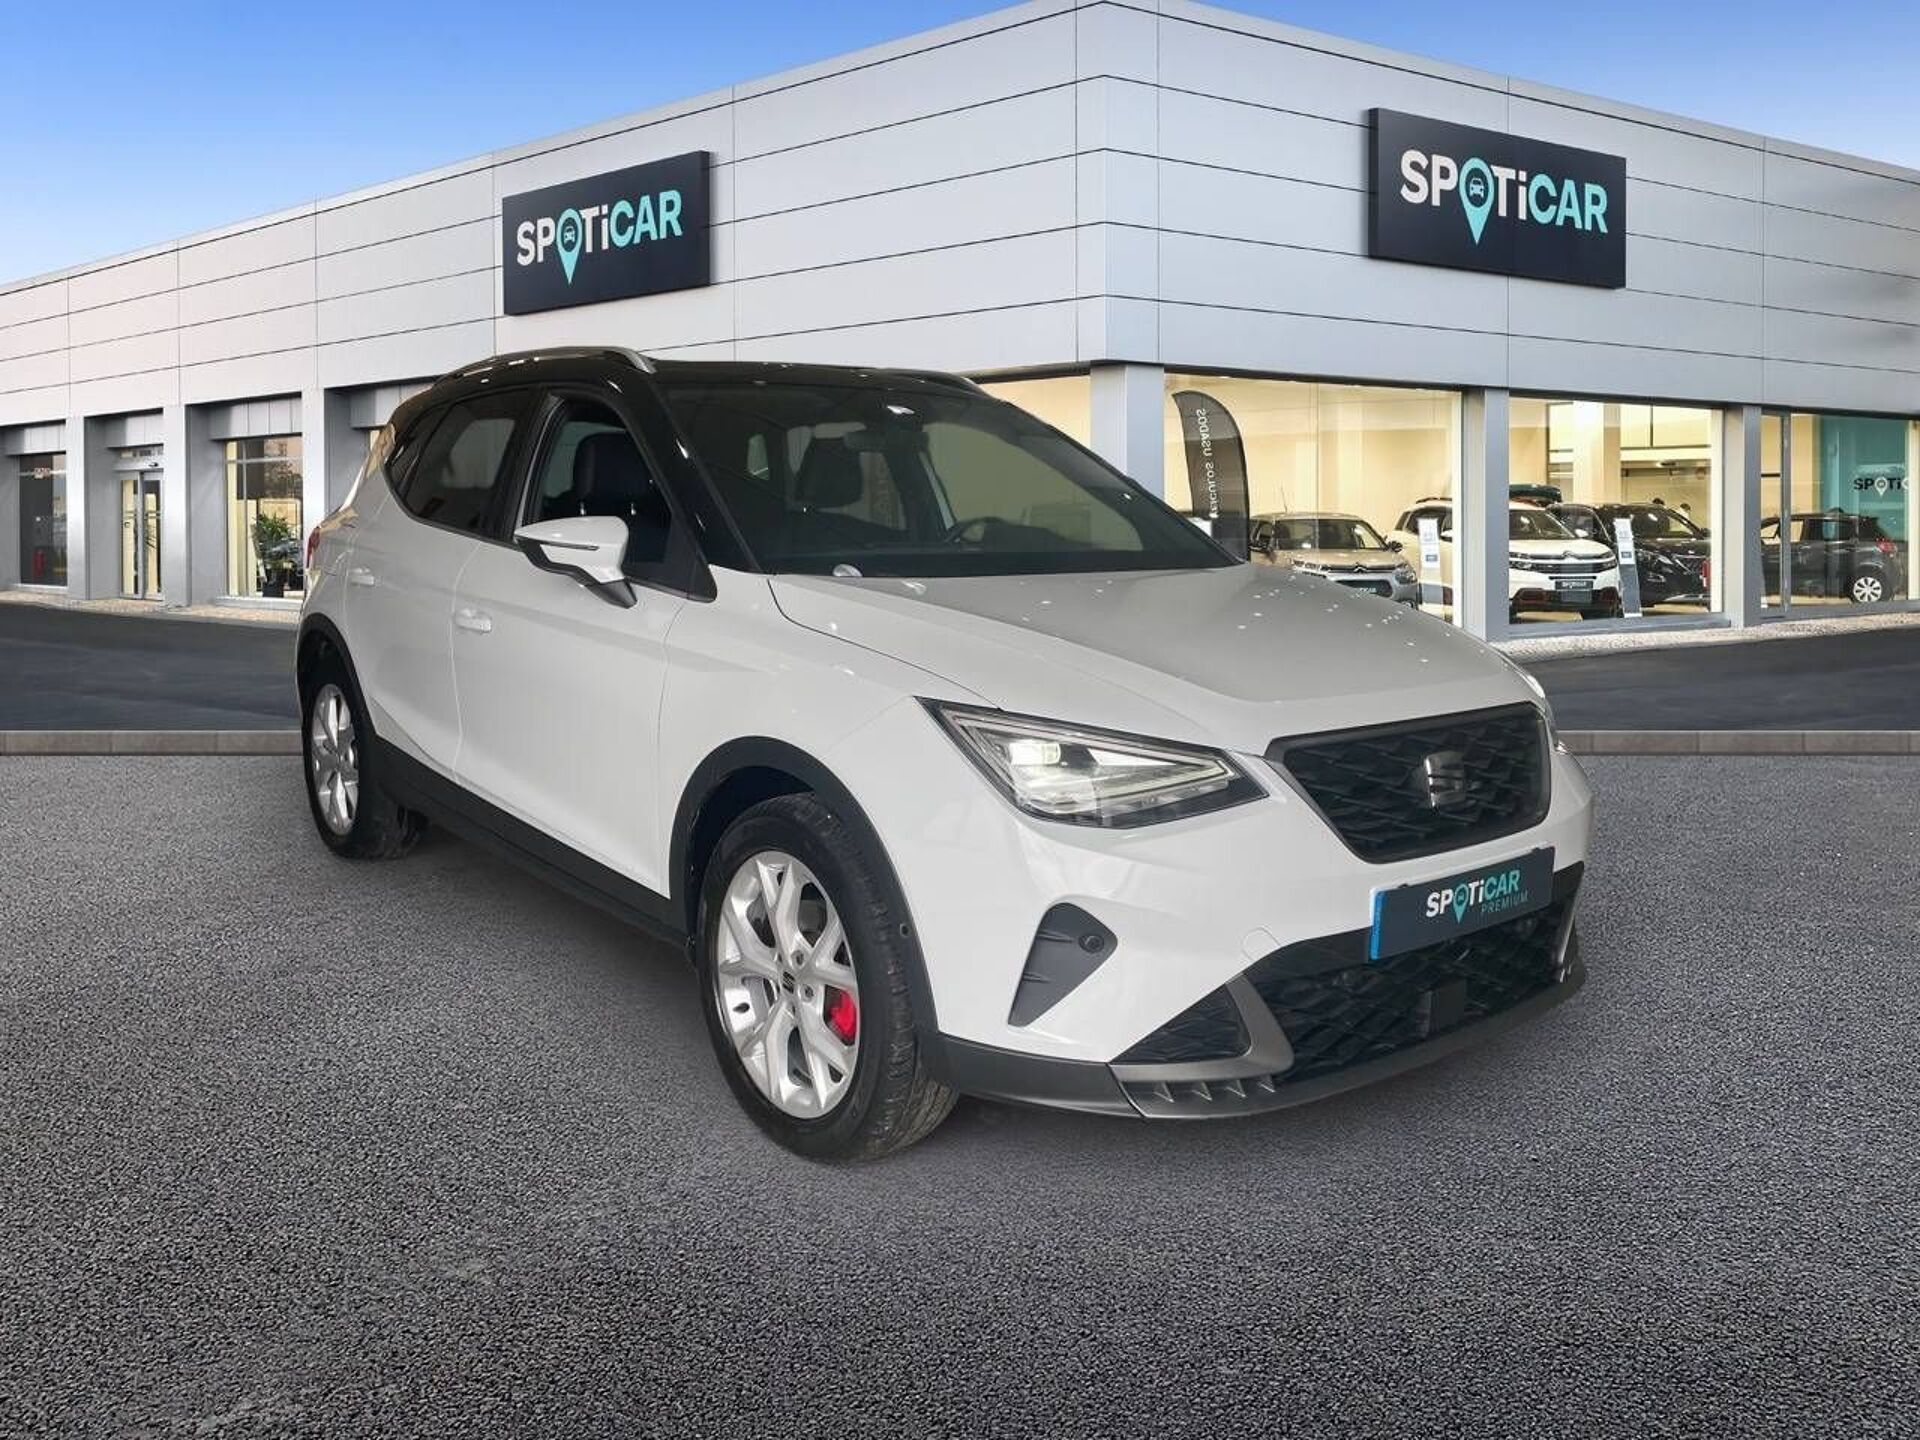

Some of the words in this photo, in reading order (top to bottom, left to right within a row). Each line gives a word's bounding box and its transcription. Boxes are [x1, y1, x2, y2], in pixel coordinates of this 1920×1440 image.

[1400, 149, 1608, 245] SPOTiCAR
[516, 189, 684, 285] SPOTiCAR
[1425, 870, 1521, 924] SPOTiCAR
[1481, 892, 1529, 914] PREMIUM
